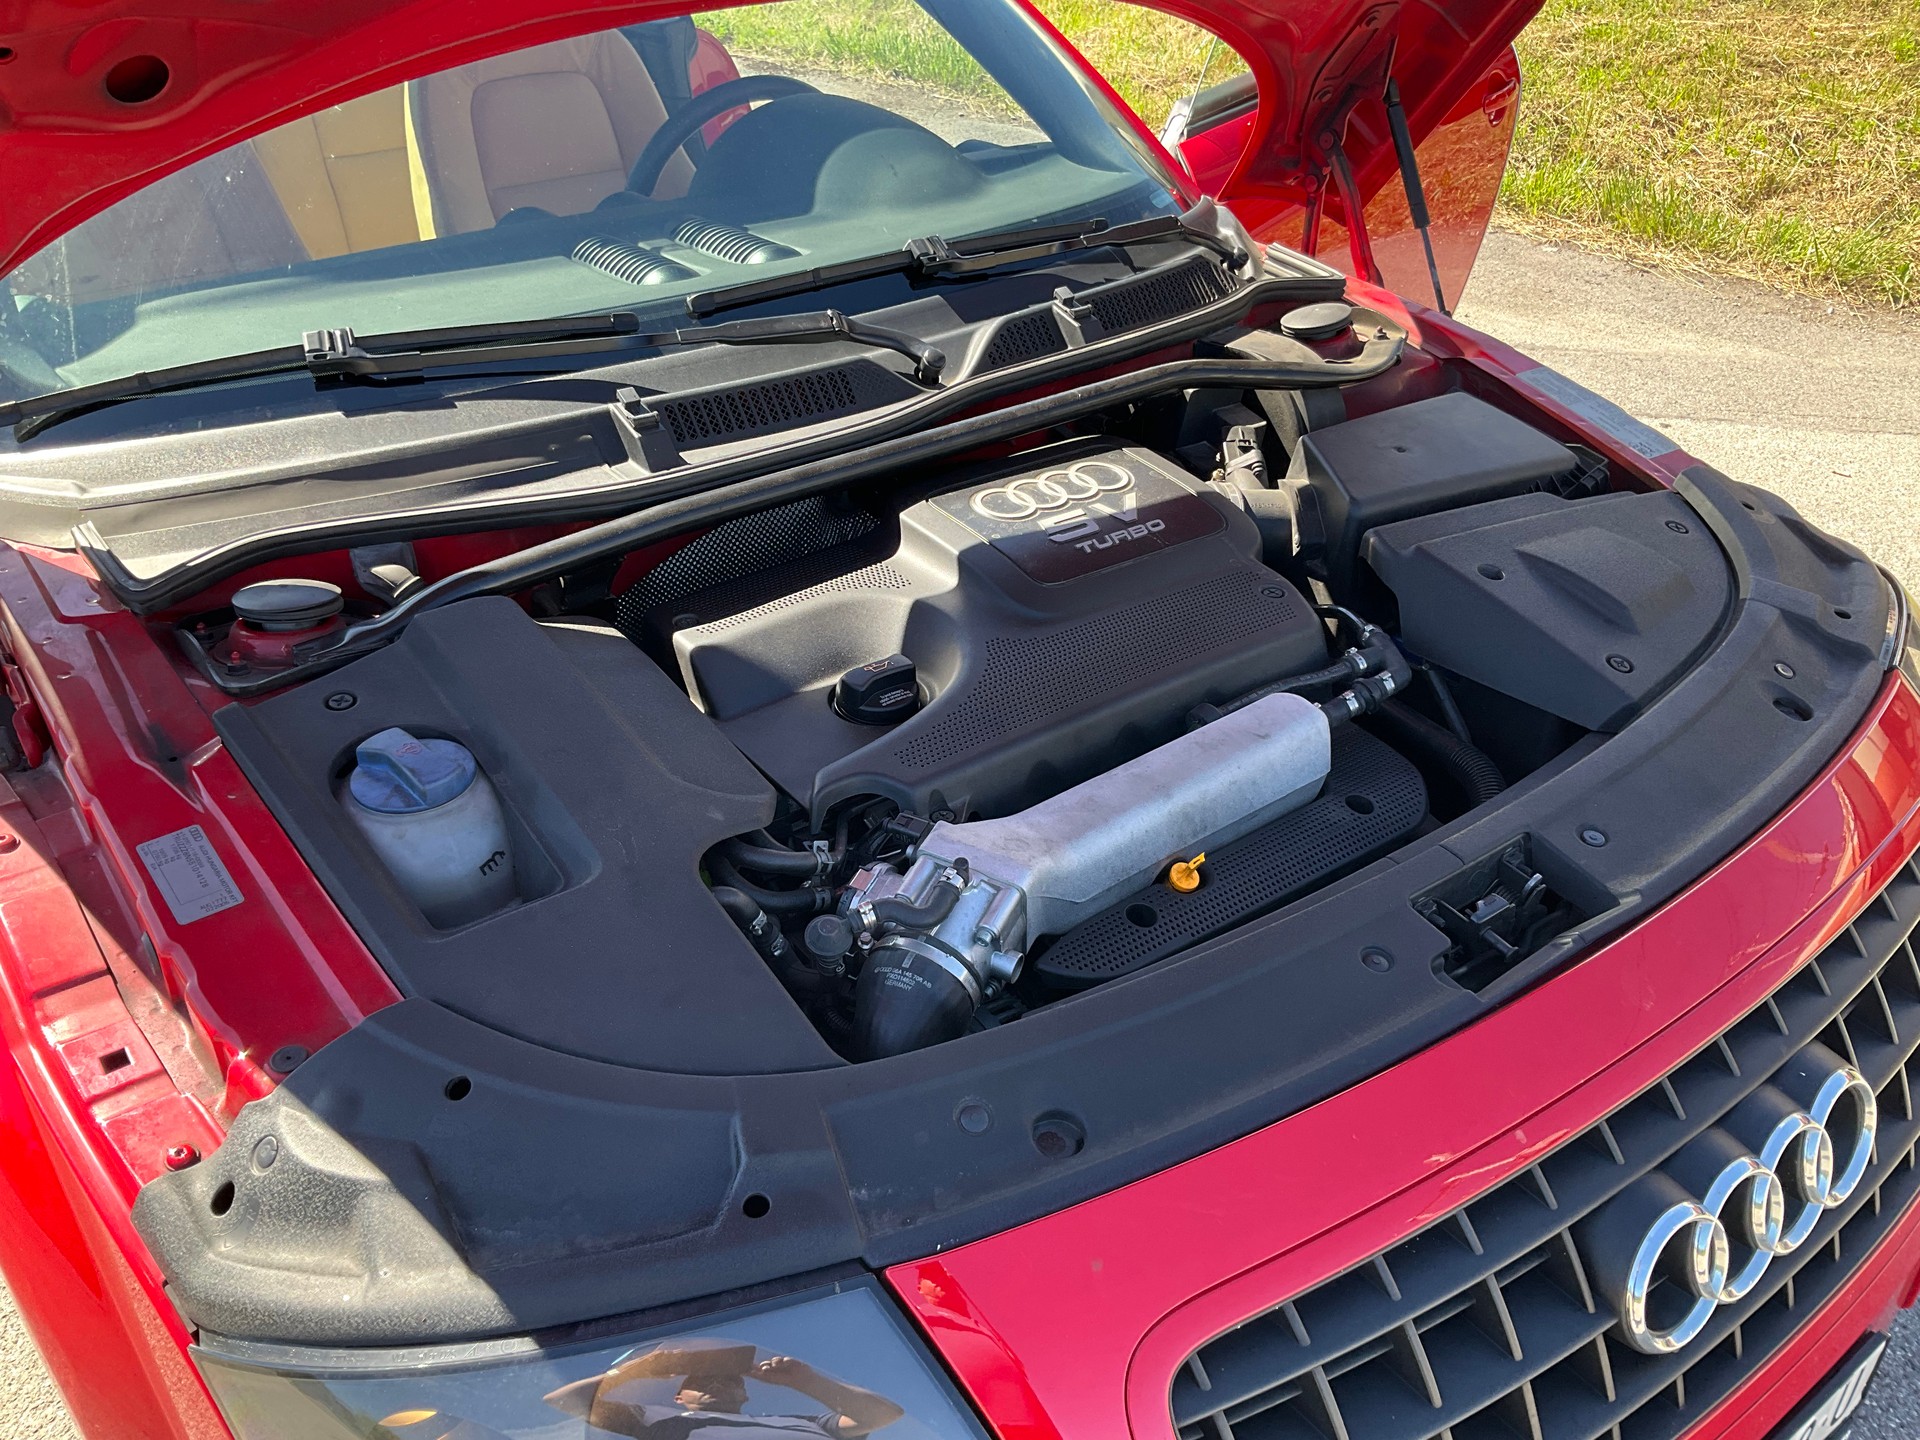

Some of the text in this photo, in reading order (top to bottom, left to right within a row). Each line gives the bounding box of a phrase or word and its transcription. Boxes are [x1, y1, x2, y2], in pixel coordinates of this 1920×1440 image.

[1038, 491, 1138, 542] 5V
[1074, 518, 1166, 553] TURBO
[884, 979, 912, 991] GERMANY
